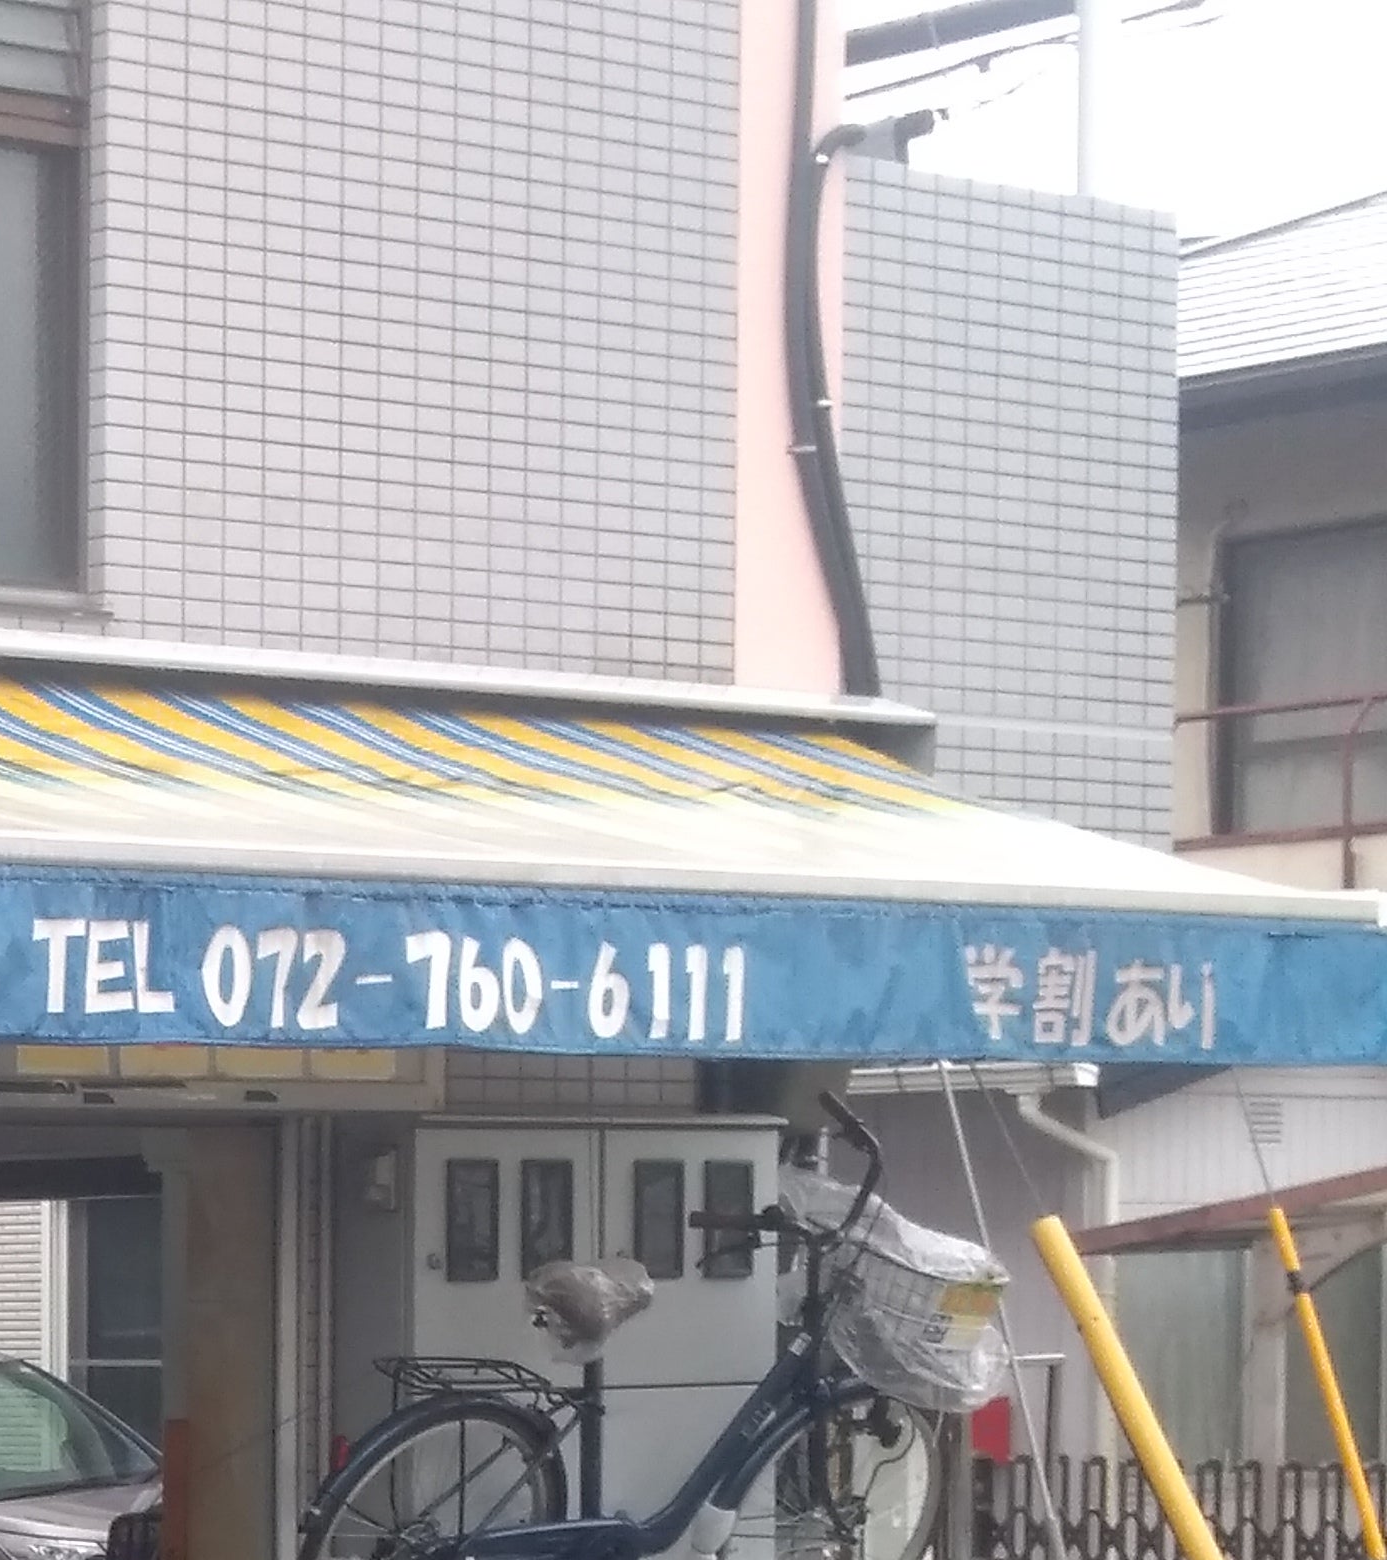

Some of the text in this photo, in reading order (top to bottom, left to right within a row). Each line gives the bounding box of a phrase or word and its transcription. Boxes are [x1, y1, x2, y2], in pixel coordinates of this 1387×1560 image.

[32, 918, 746, 1042] TEL 072-760-6111
[964, 943, 1217, 1050] 学割あり
